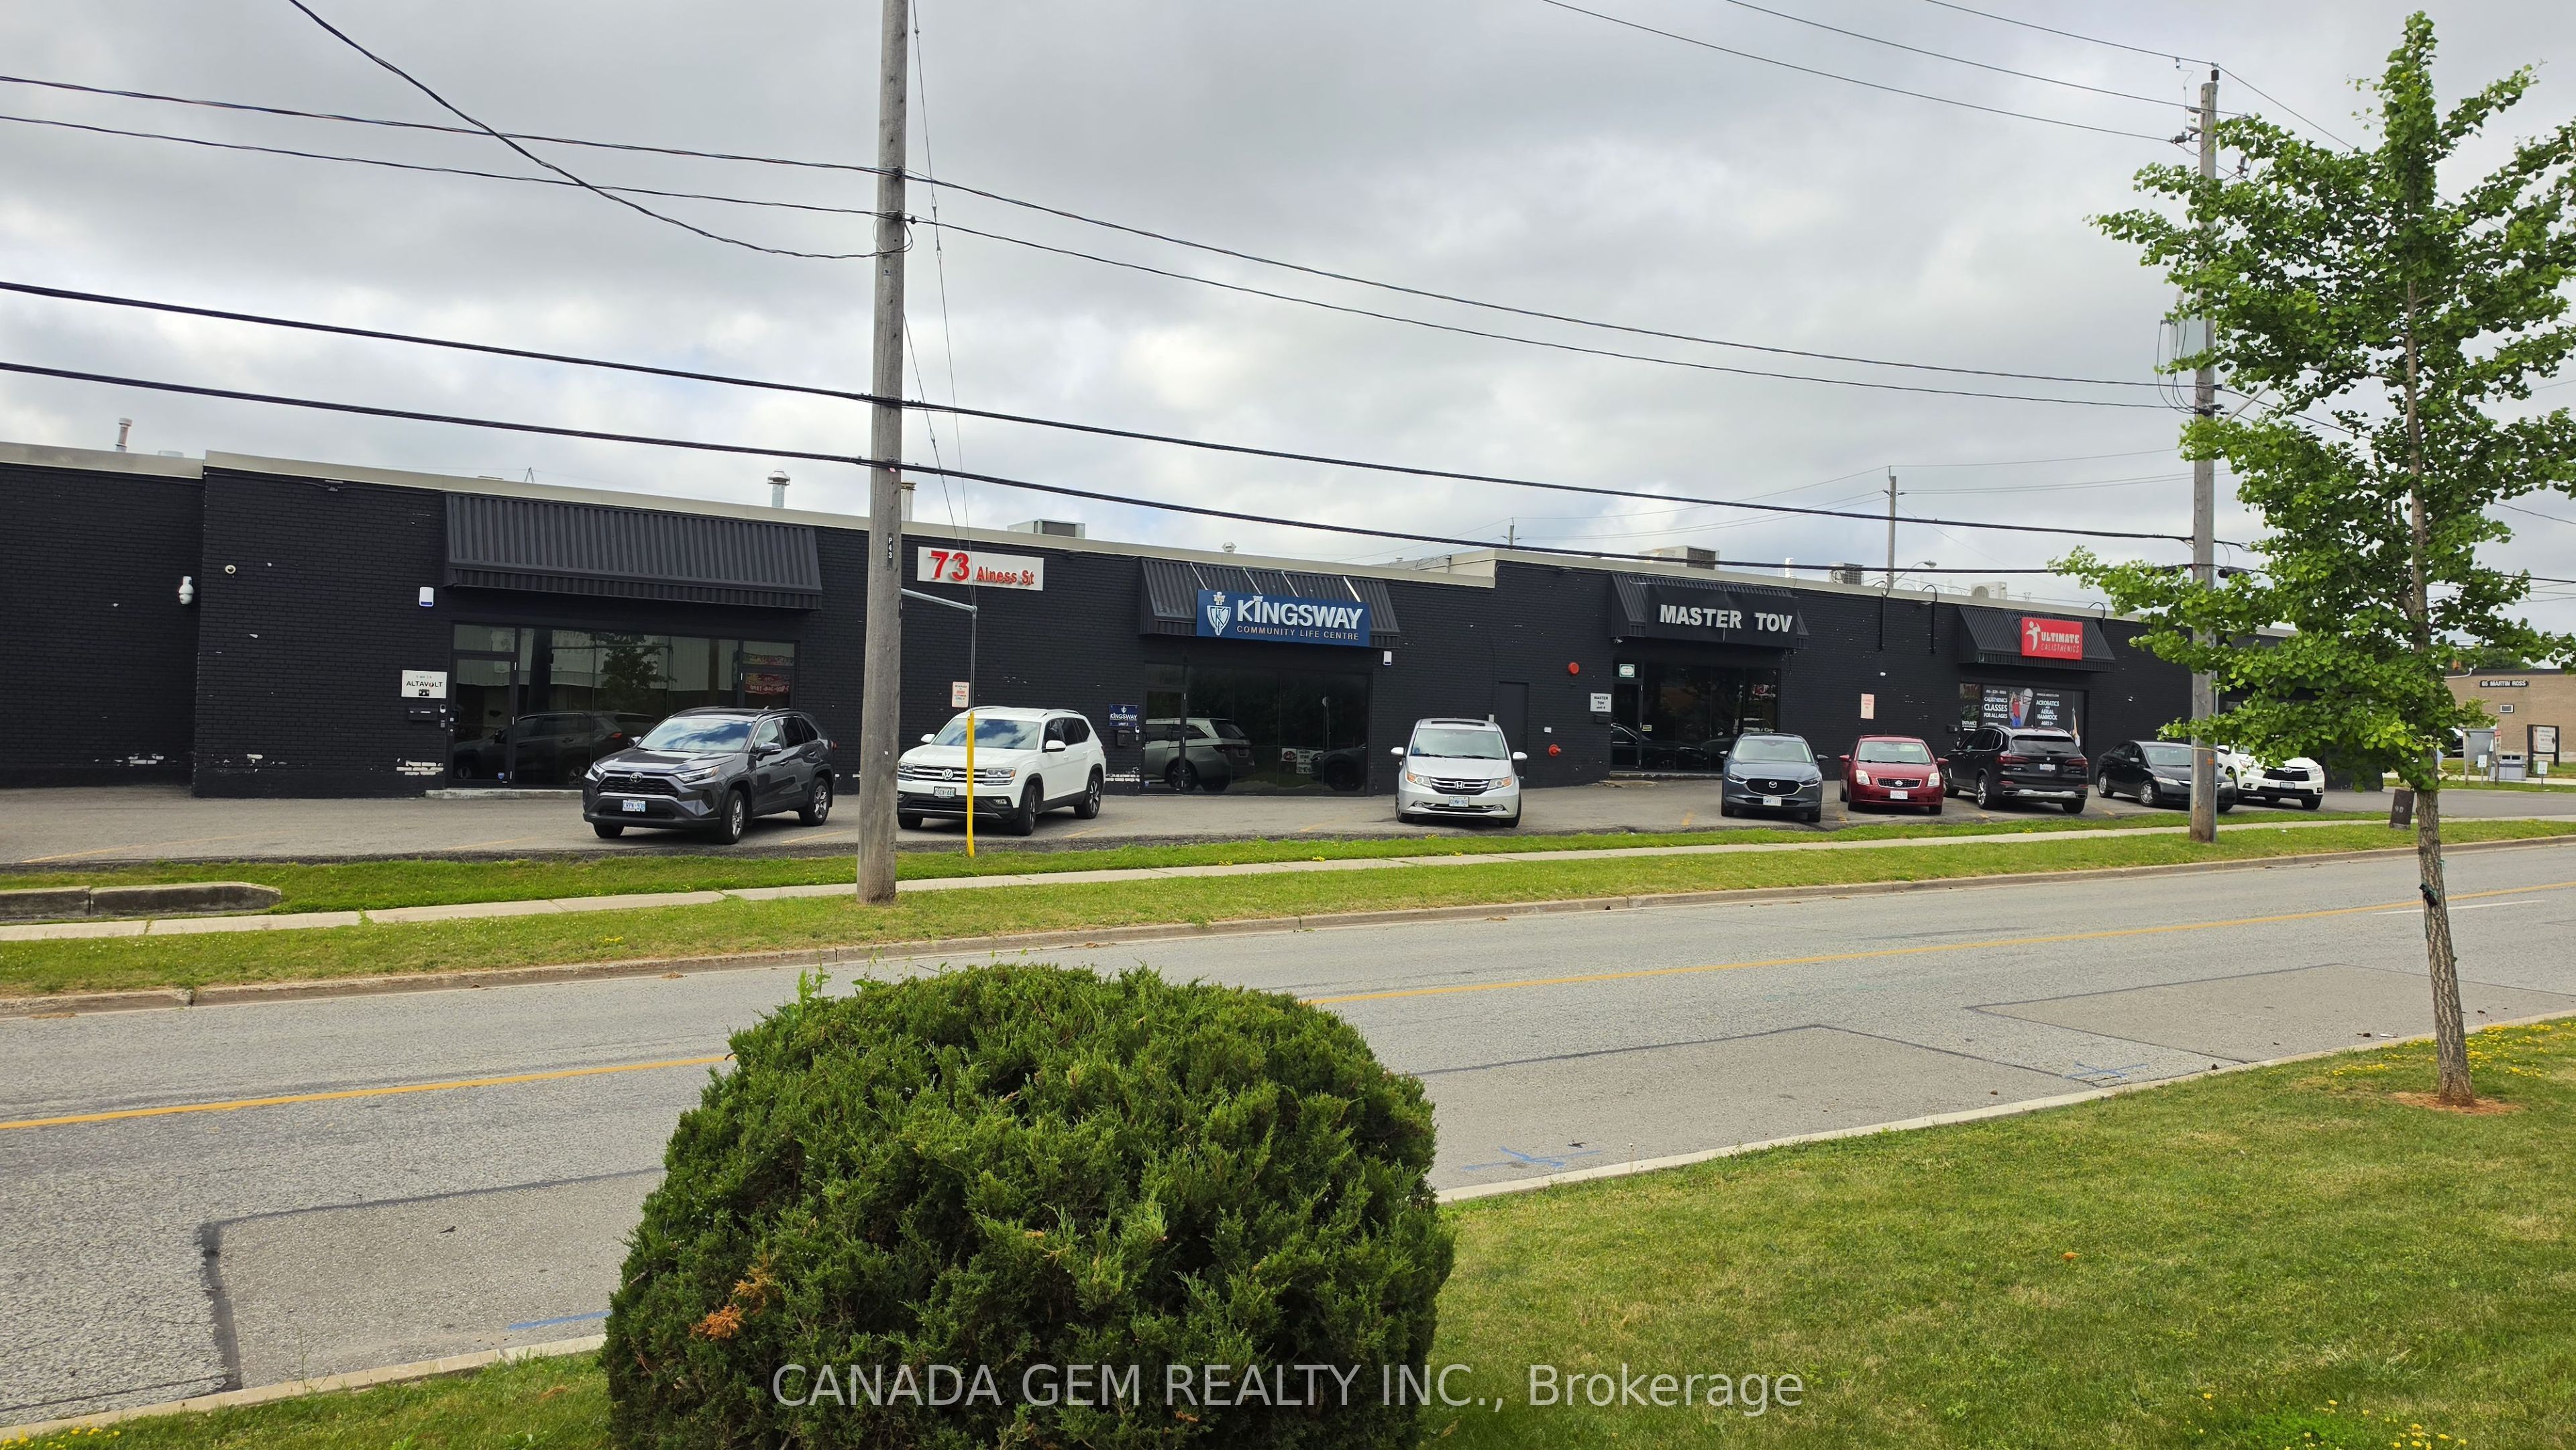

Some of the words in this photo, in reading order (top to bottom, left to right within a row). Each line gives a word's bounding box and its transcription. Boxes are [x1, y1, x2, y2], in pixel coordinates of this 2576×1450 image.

[930, 550, 970, 582] 73
[976, 566, 1018, 584] Alness
[1021, 570, 1034, 586] St
[1236, 596, 1364, 629] KINGSWAY
[1660, 604, 1742, 629] MASTER
[1754, 612, 1793, 633] TOV
[1236, 625, 1295, 637] COMMUNITY
[1324, 631, 1359, 640] CENTRE
[2041, 631, 2080, 643] ULTIMATE
[2041, 643, 2080, 653] CALISTHENICS
[1984, 703, 2008, 712] CLASSES
